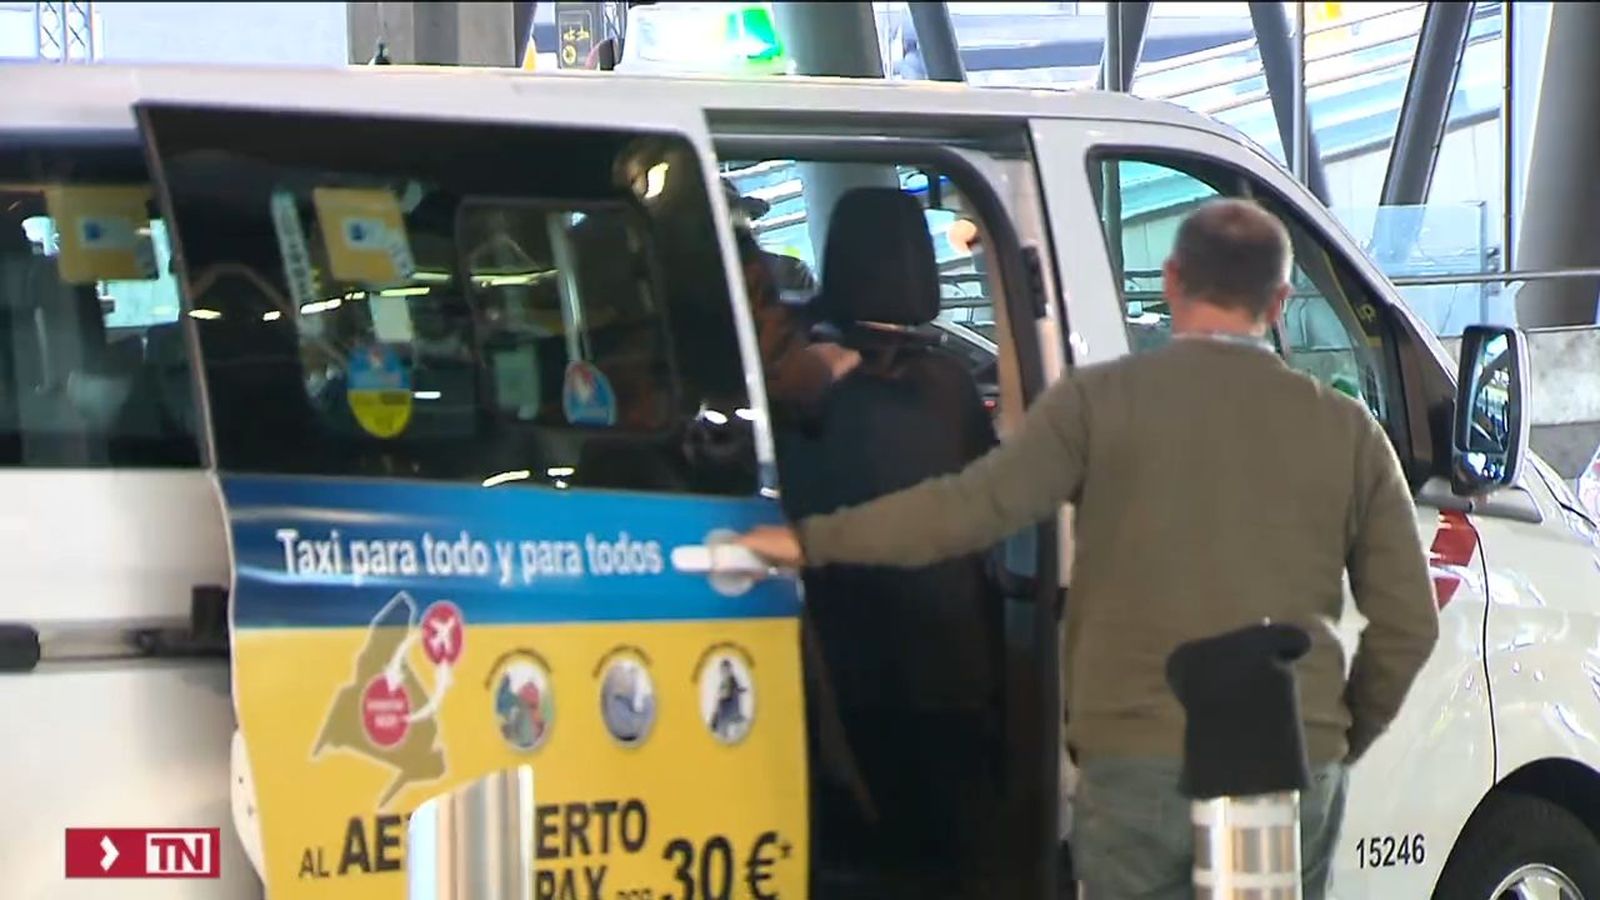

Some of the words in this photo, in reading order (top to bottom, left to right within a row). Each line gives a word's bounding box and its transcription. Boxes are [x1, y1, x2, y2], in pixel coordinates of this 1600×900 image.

[276, 528, 342, 576] Taxi
[350, 540, 418, 587] para
[423, 530, 489, 577] todo
[496, 540, 513, 586] y
[520, 540, 583, 586] para
[585, 531, 664, 576] todos
[298, 846, 330, 878] AL
[1356, 833, 1425, 869] 15246
